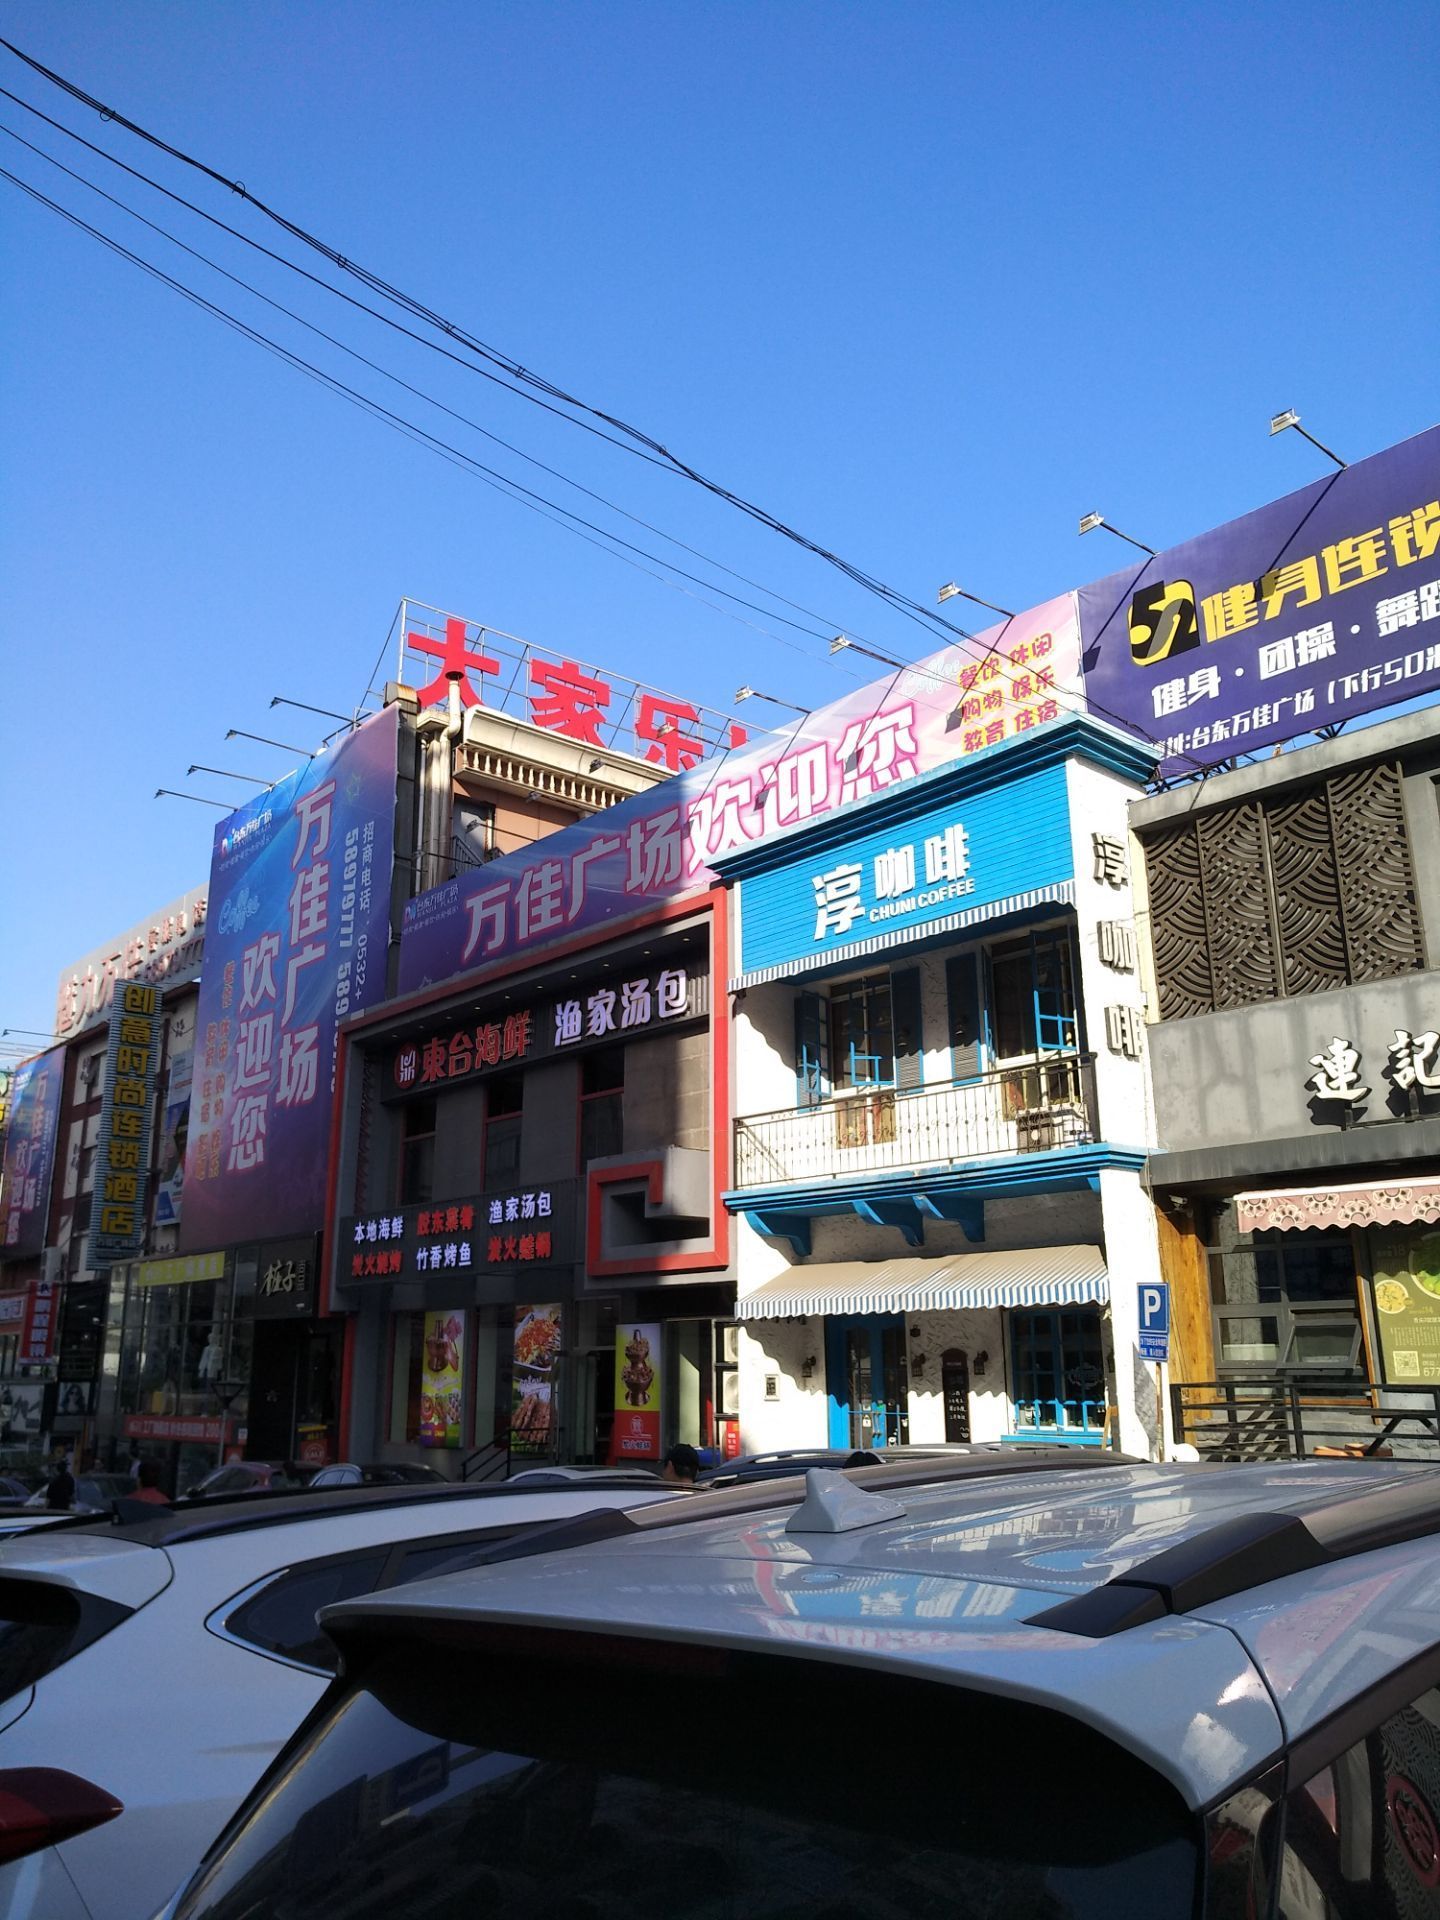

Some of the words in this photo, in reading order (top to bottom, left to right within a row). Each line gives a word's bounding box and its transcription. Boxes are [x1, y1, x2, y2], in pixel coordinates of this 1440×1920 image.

[1009, 633, 1053, 667] 休闲
[408, 618, 748, 772] 大家乐
[962, 689, 1004, 722] 购物
[1012, 665, 1055, 701] 娱乐
[963, 719, 1005, 753] 教育
[812, 823, 970, 941] 淳咖啡
[869, 897, 917, 923] CHUNI
[918, 879, 975, 909] COFFEE
[276, 780, 336, 1106] 万佳广场
[1092, 832, 1142, 1056] 淳咖啡
[554, 968, 688, 1047] 渔家汤包
[227, 936, 279, 1171] 欢迎您
[101, 983, 157, 1235] 创意时尚连锁酒店
[353, 1215, 404, 1245] 本地海鲜
[488, 1191, 552, 1225] 渔家汤包
[415, 1241, 473, 1271] 竹香烤鱼
[1144, 1288, 1161, 1327] P
